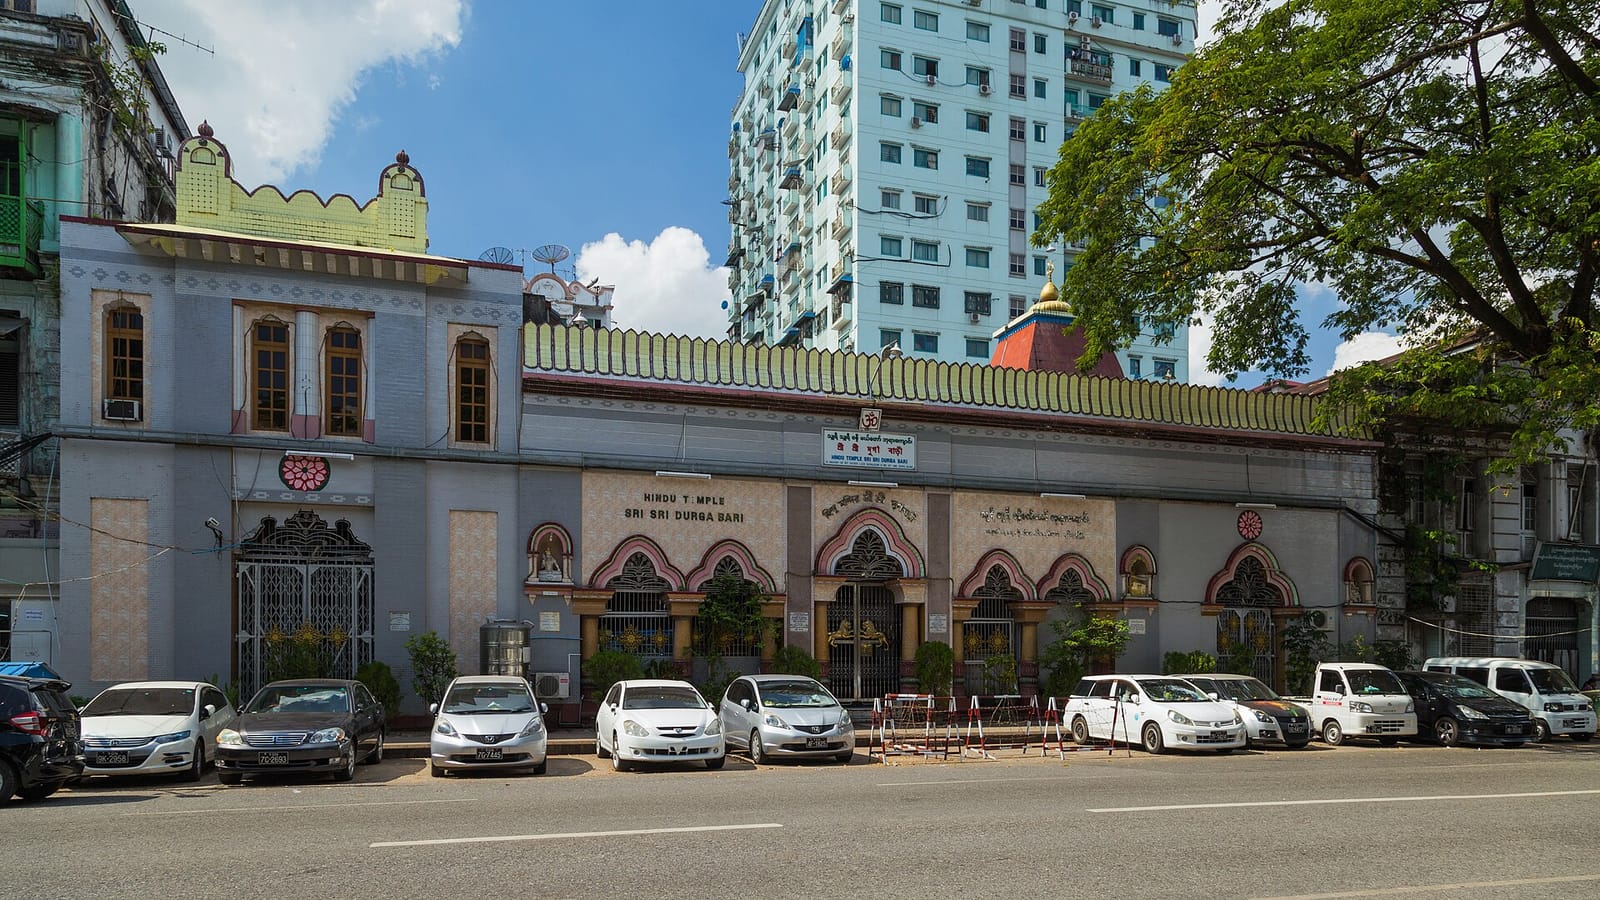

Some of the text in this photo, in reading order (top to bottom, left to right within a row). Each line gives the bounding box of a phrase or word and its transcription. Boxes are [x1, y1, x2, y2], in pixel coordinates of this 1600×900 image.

[643, 493, 725, 505] HINDU TMPLE
[624, 508, 744, 523] SRI SRI DURGA BARI
